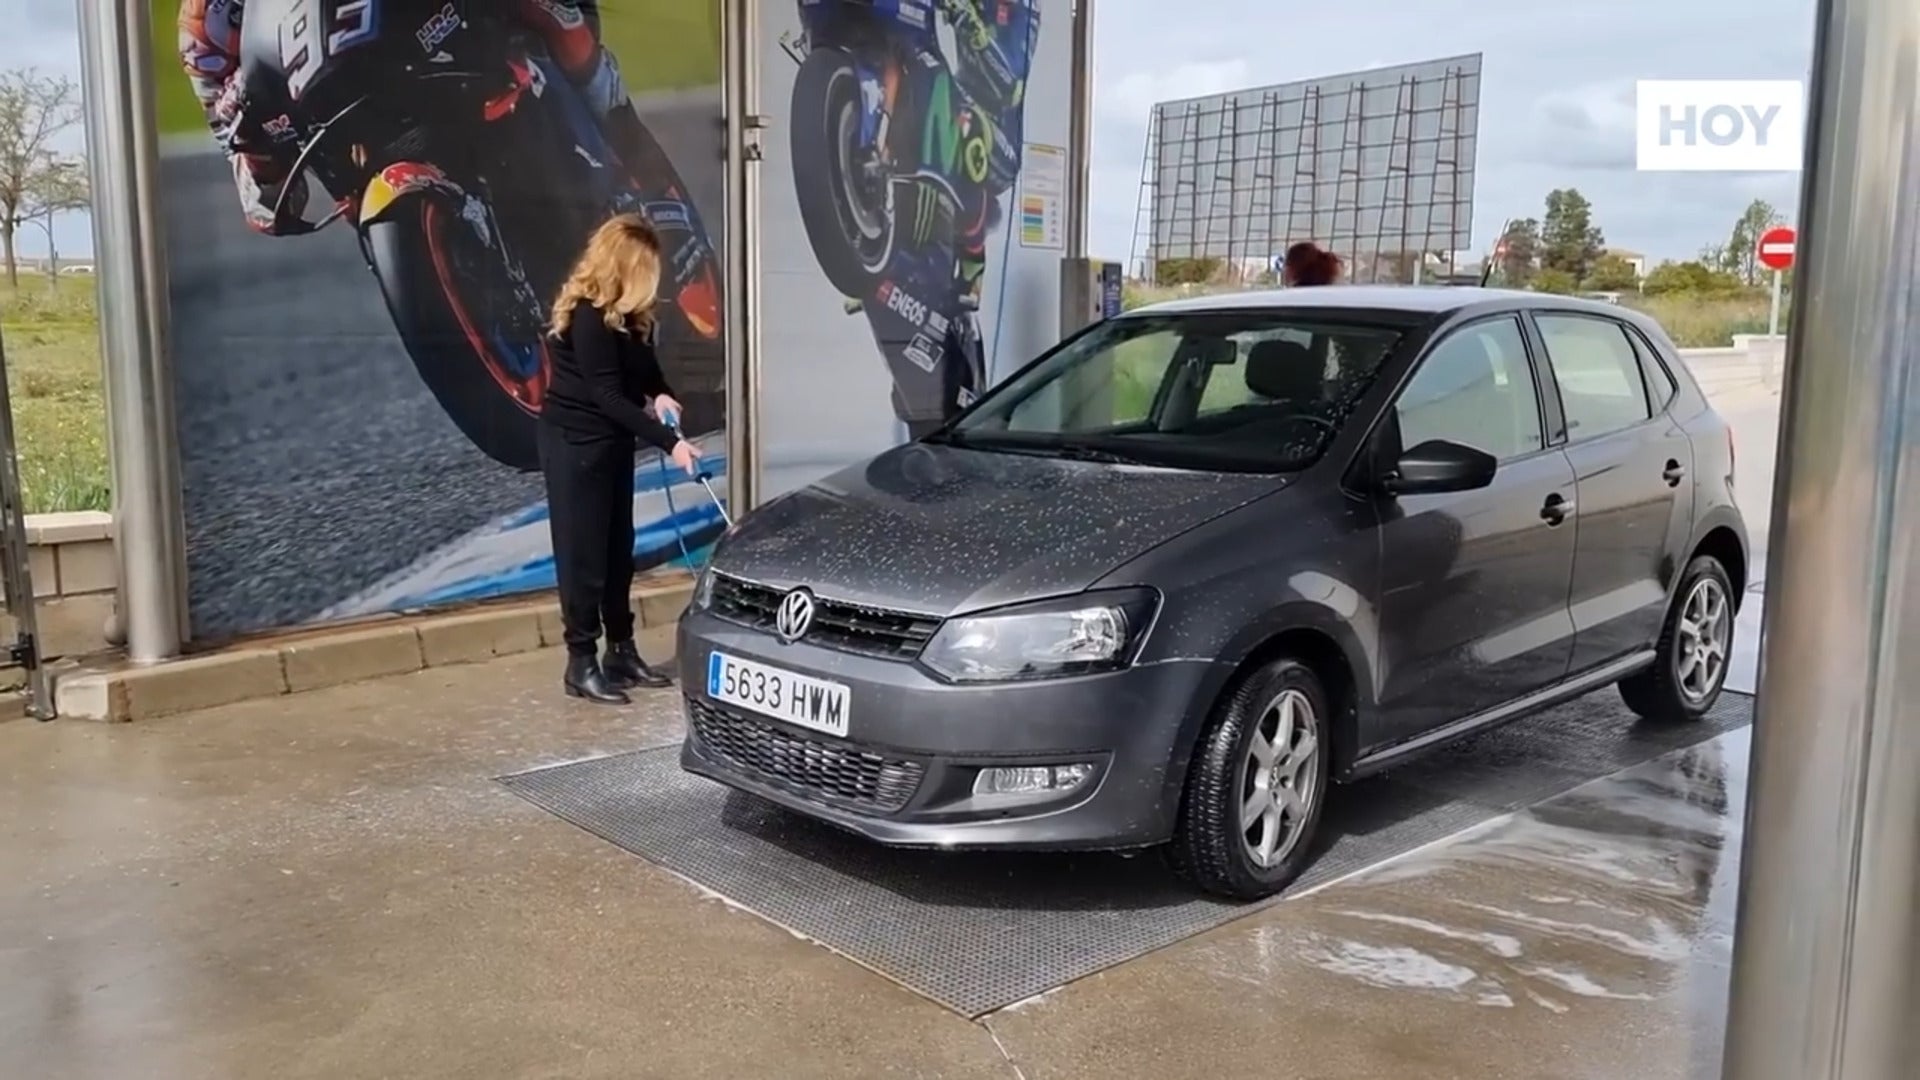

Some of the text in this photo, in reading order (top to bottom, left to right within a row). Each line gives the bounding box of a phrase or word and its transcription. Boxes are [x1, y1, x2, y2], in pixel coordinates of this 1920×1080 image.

[887, 286, 927, 326] ENEOS
[724, 662, 842, 728] 5633 HWM
